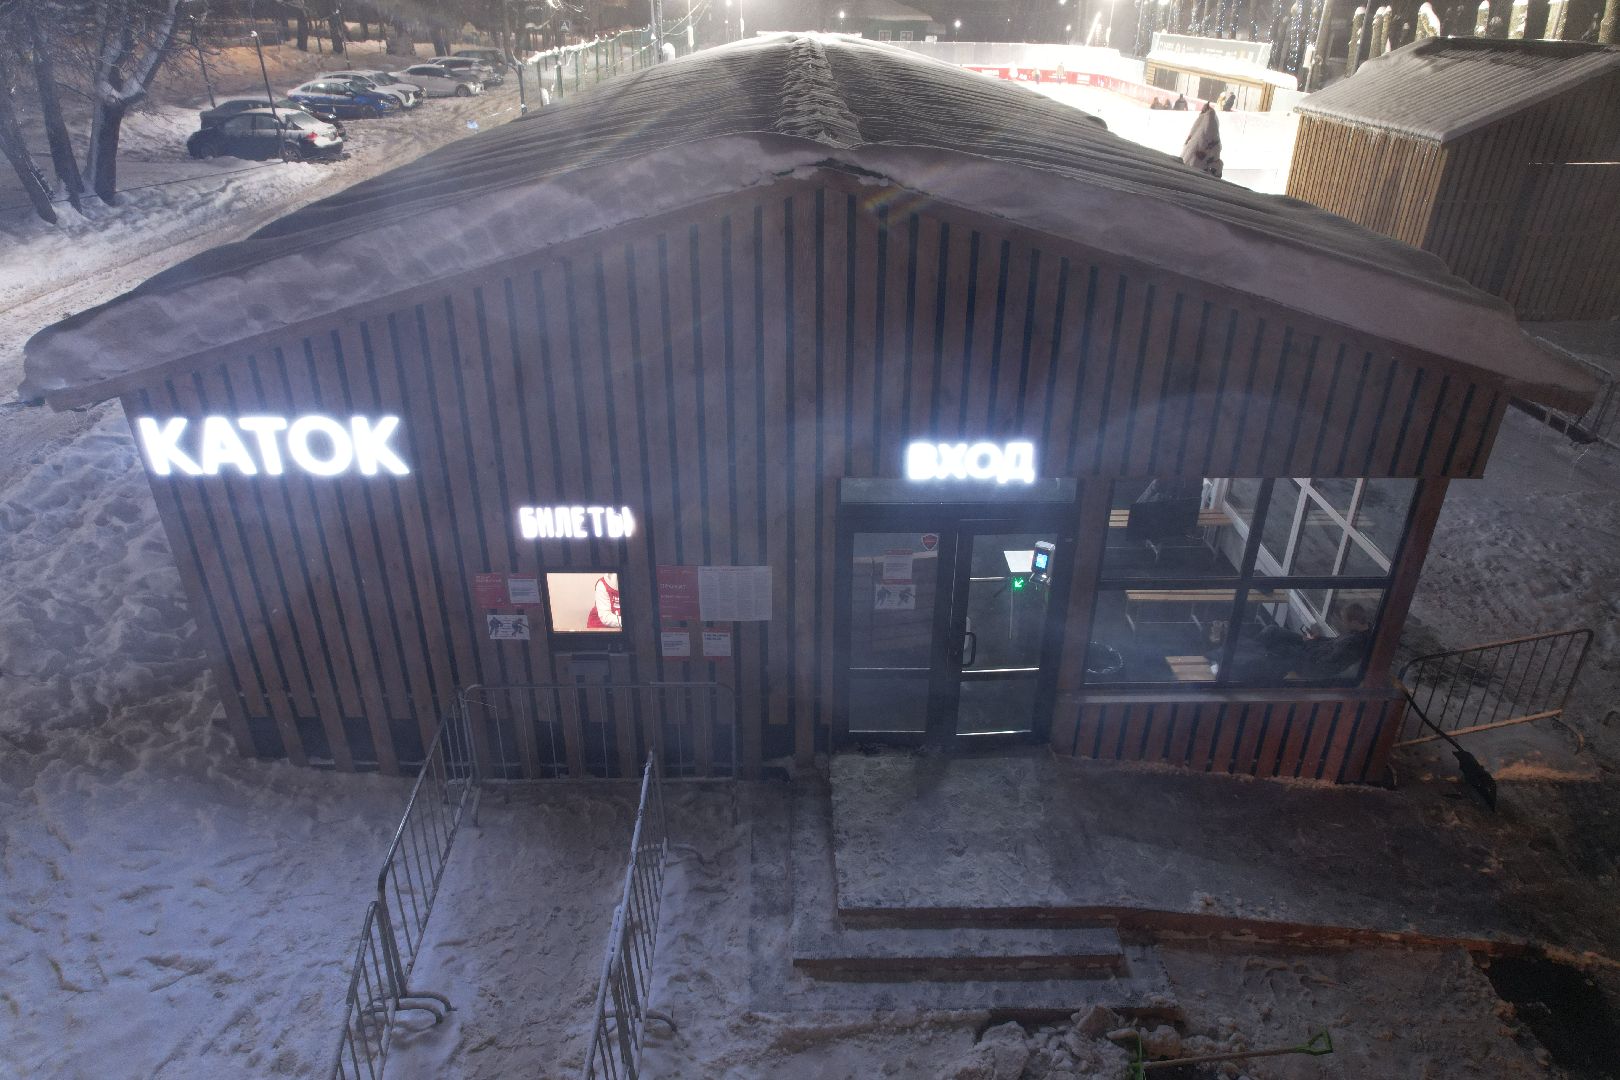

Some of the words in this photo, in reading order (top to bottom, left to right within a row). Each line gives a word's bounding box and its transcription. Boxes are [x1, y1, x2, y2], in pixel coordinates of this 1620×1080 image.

[138, 415, 410, 476] КАТОК
[907, 441, 1035, 484] ВХОД
[519, 506, 634, 539] БИЛЕТЫ
